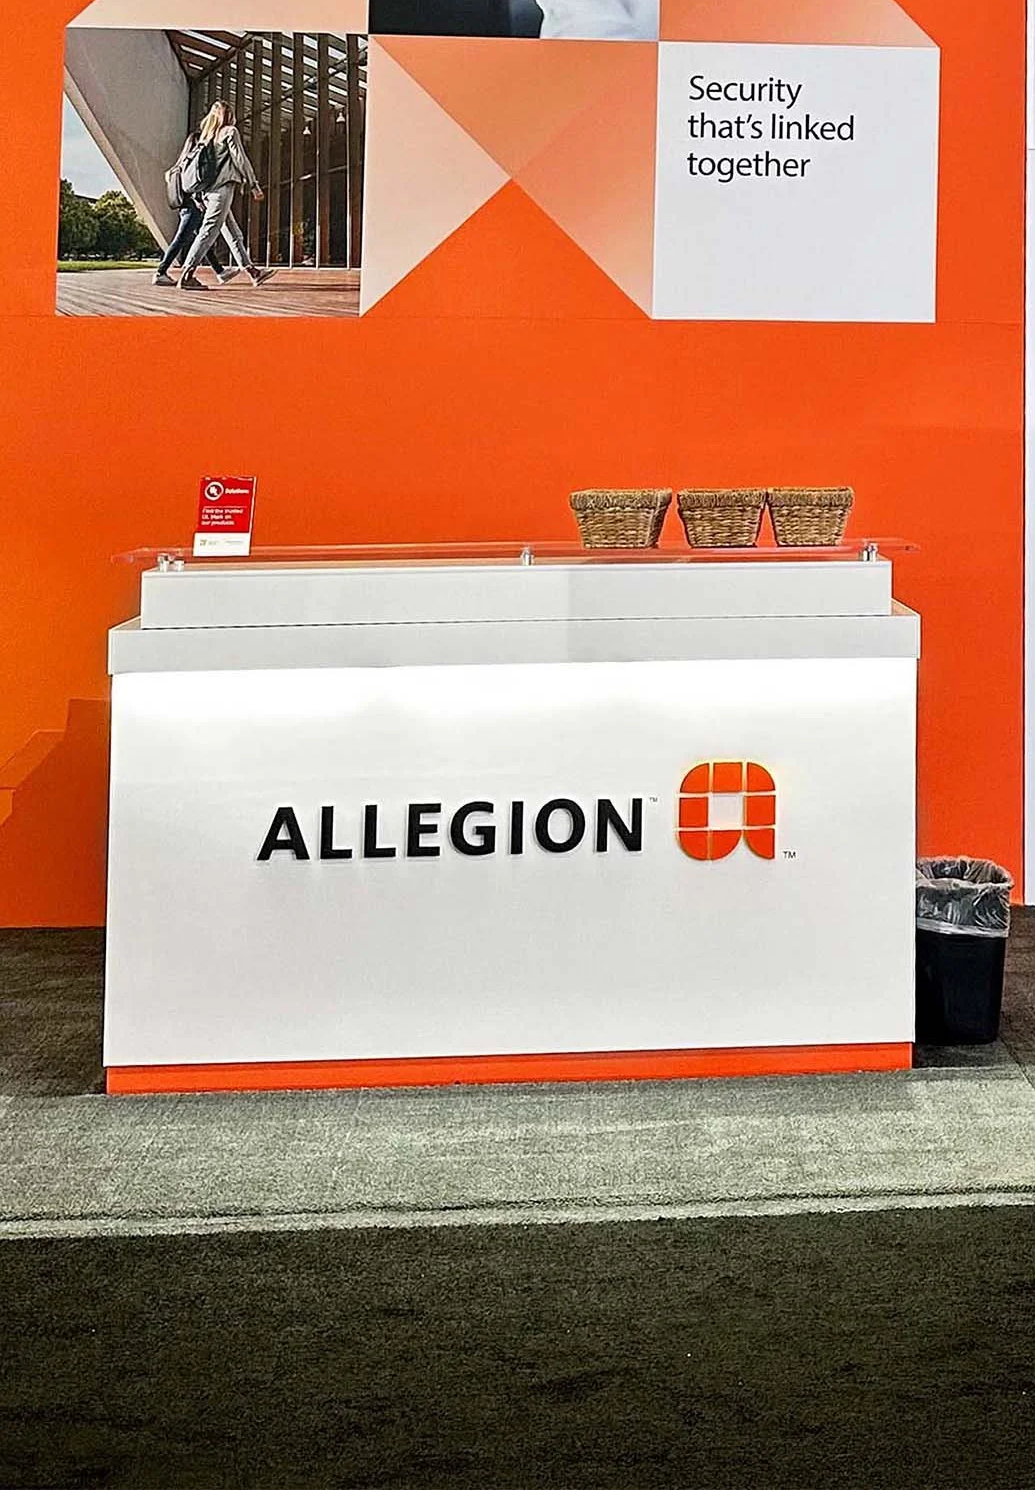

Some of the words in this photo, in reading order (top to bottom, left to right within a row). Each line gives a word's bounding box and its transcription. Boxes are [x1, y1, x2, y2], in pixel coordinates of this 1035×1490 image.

[688, 74, 803, 110] Security
[770, 112, 855, 141] linked
[686, 150, 812, 184] together
